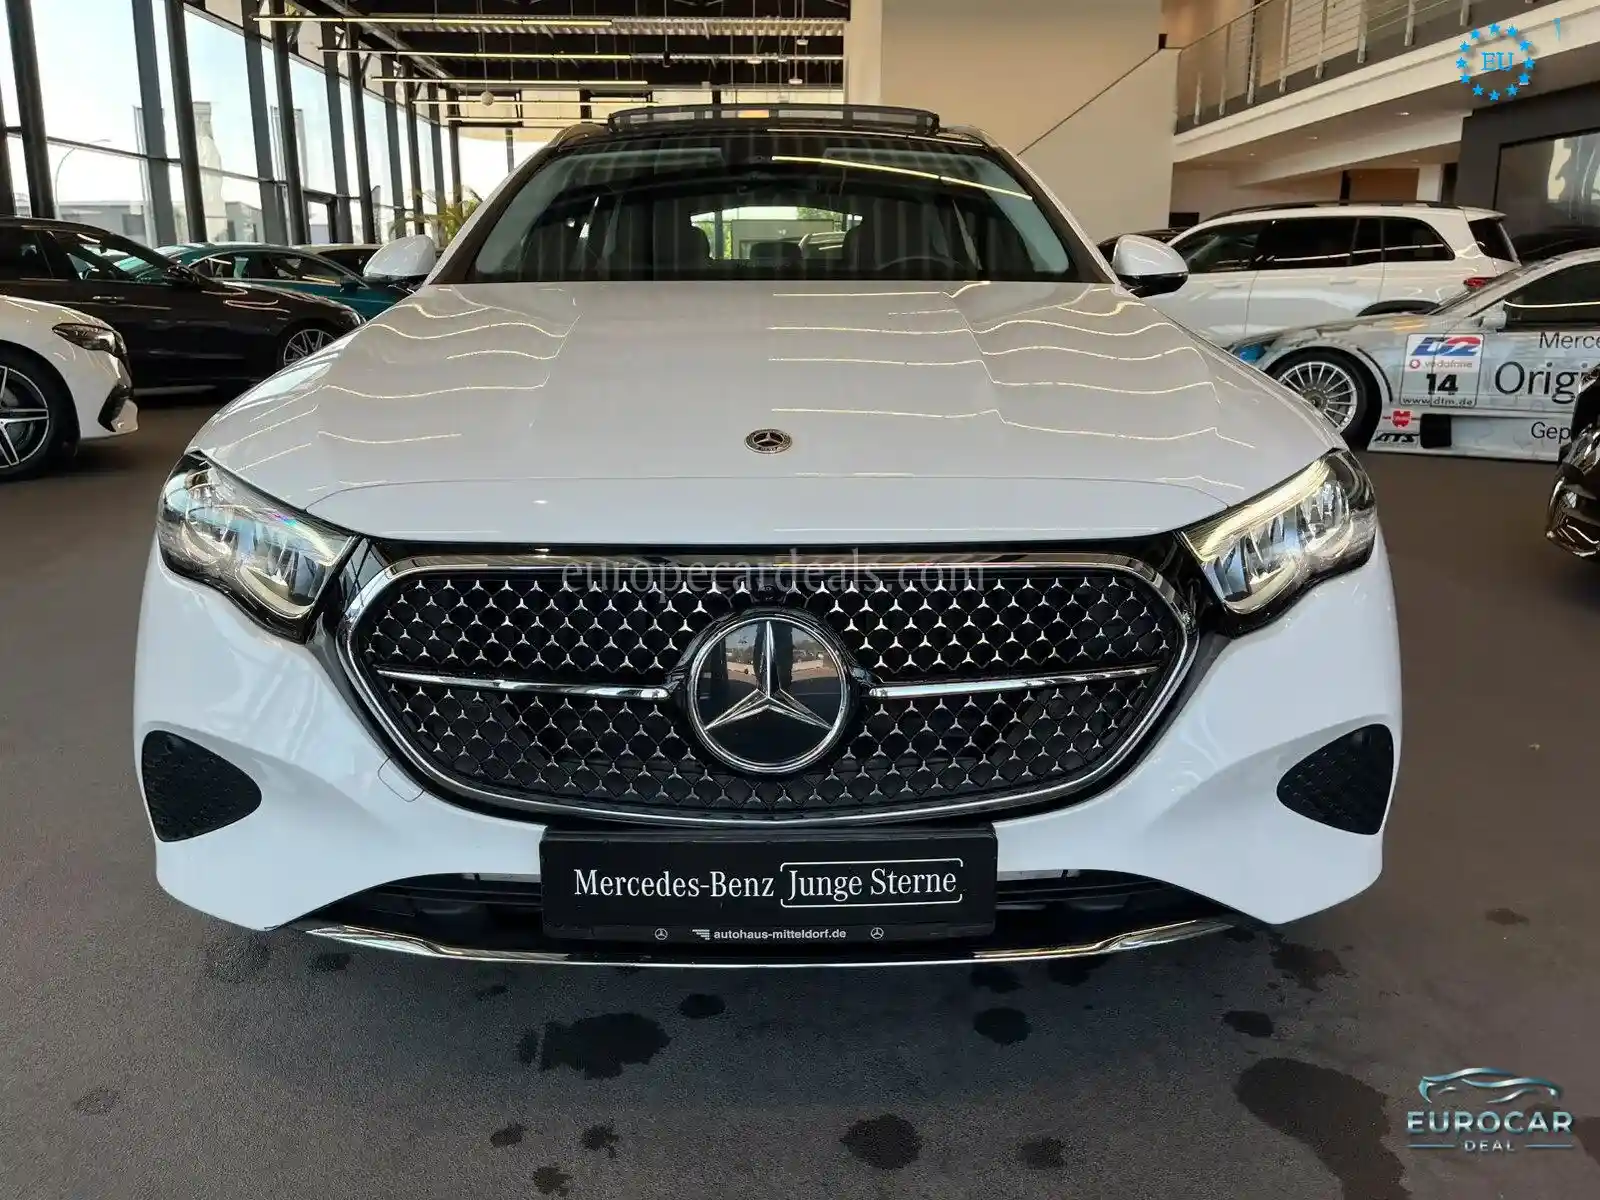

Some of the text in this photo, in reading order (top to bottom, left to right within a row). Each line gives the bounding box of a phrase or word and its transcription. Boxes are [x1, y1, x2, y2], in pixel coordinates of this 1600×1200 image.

[1426, 373, 1458, 395] 14
[574, 868, 956, 902] Mercedes-Benz Junge Sterne
[713, 929, 846, 940] autohaus-mitteldorf.de
